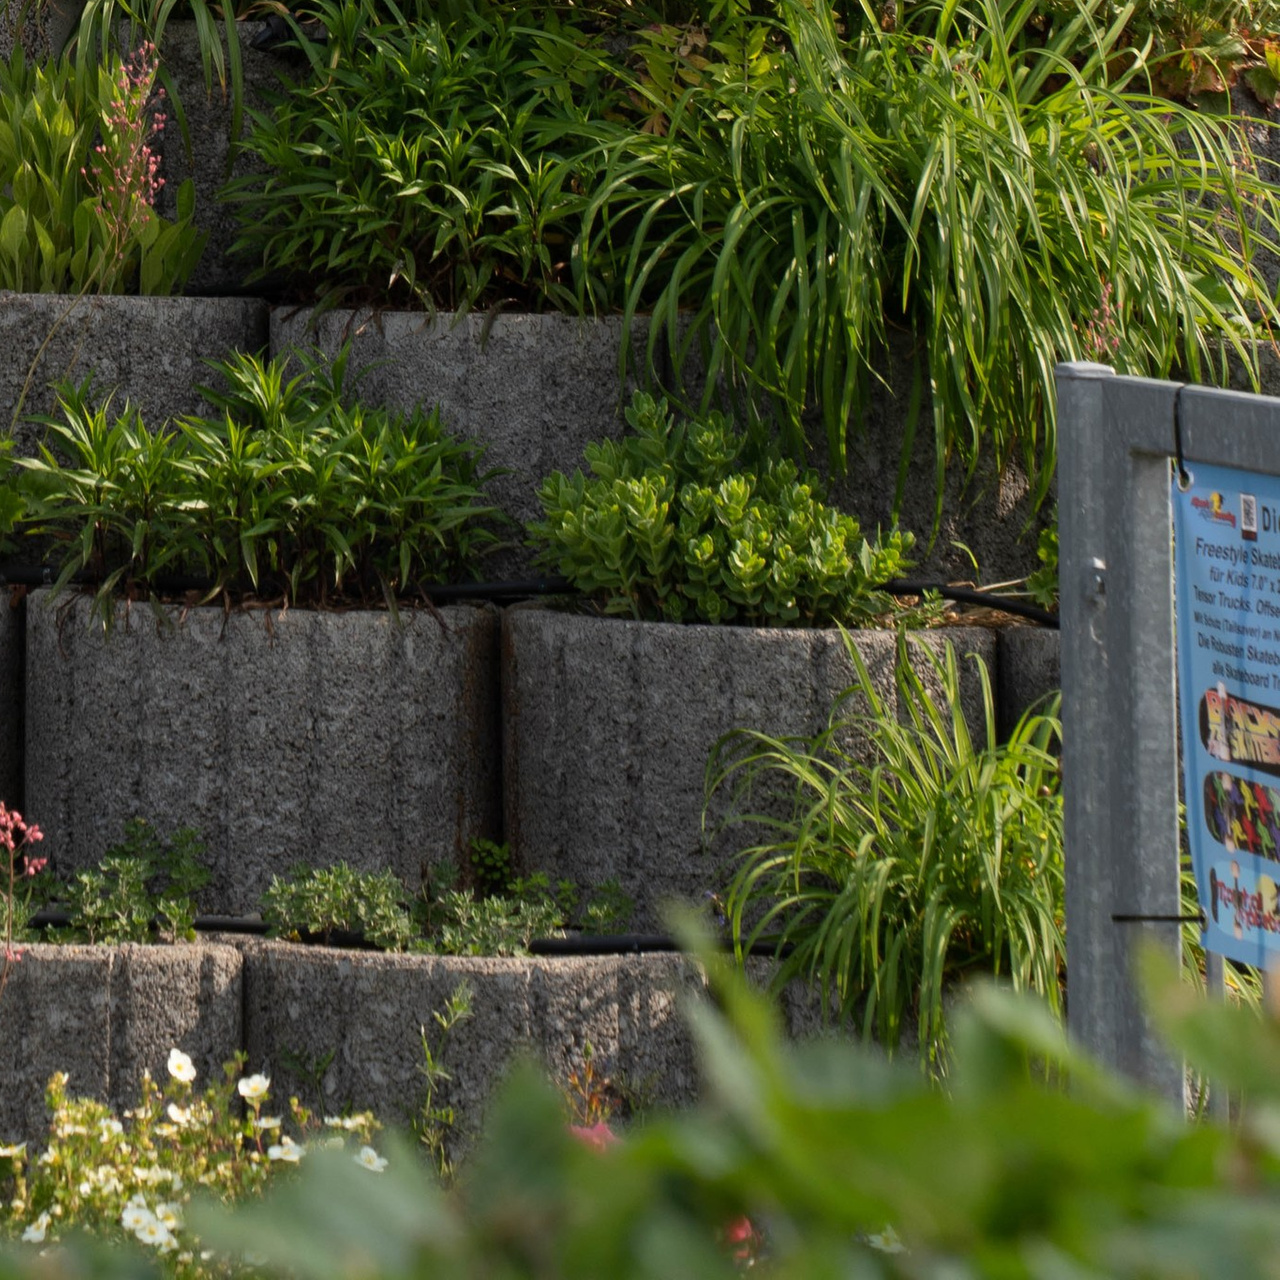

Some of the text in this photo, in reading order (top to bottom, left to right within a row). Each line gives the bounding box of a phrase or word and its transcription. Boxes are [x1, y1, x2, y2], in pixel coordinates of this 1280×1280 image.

[1261, 506, 1280, 535] Di
[1195, 537, 1280, 570] Freestyle Skate
[1227, 569, 1249, 588] Kids
